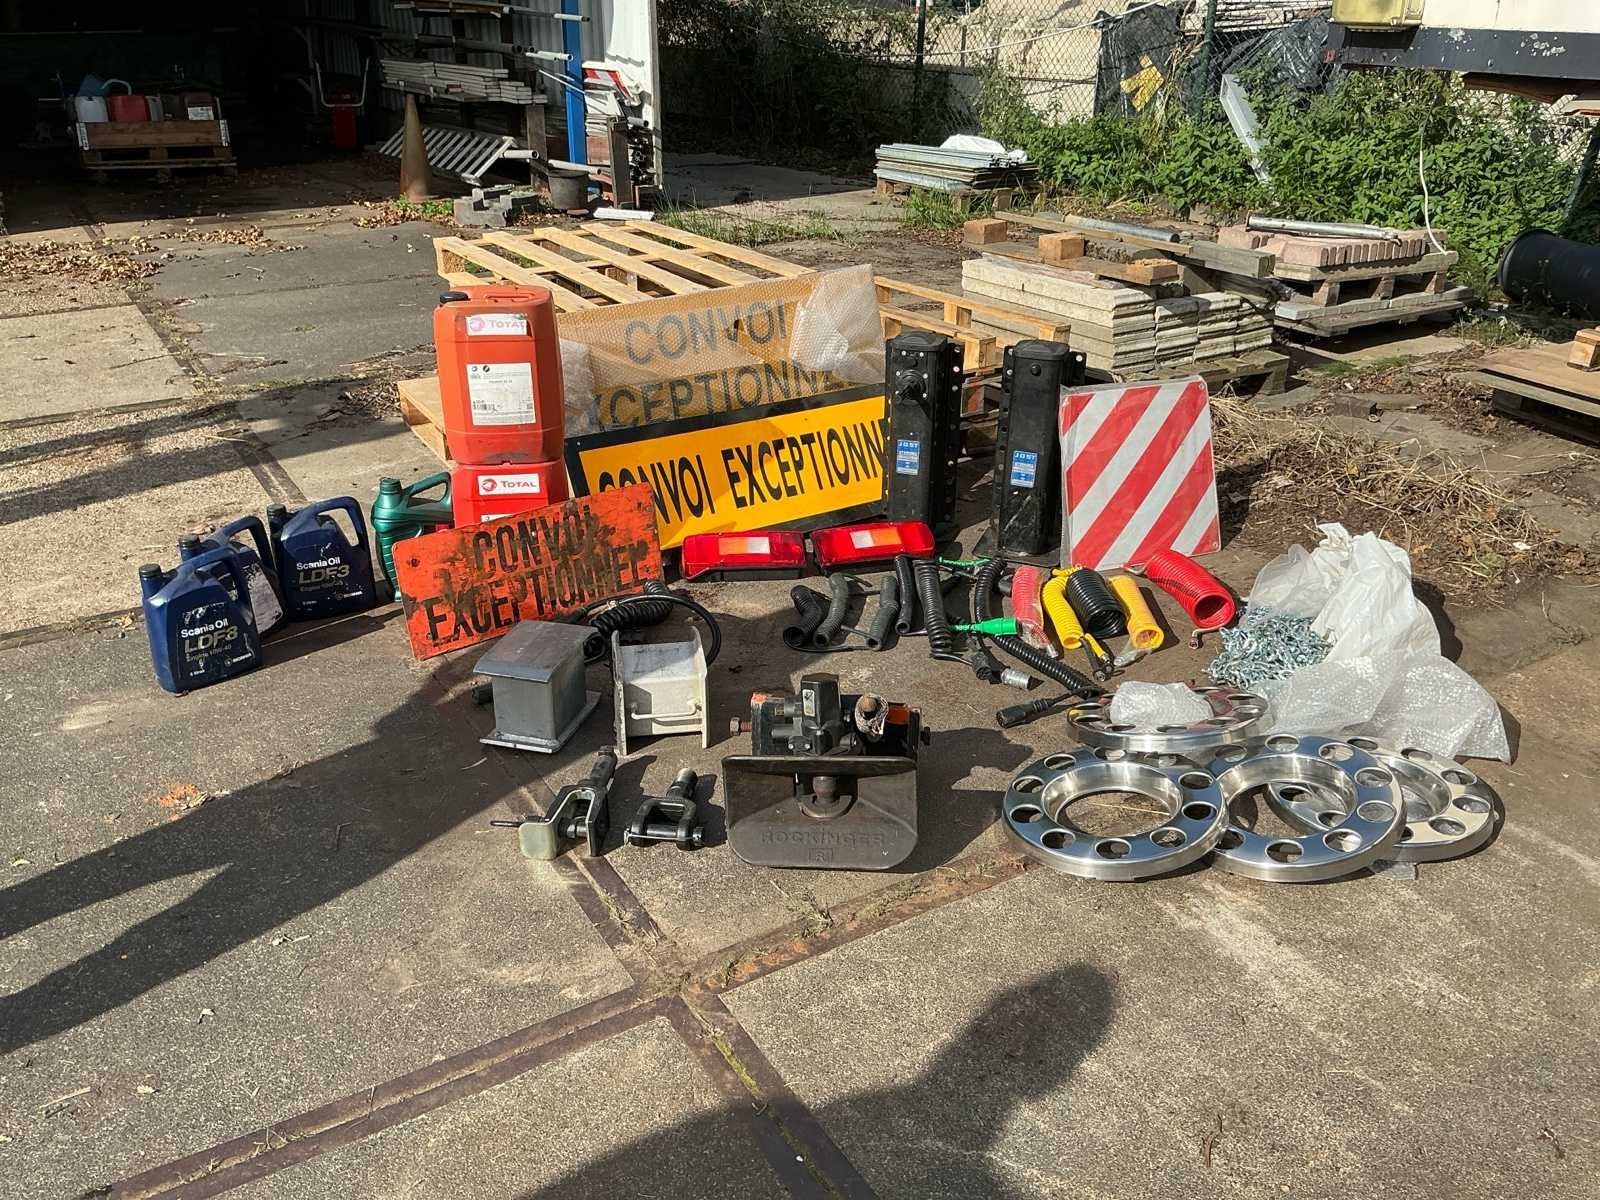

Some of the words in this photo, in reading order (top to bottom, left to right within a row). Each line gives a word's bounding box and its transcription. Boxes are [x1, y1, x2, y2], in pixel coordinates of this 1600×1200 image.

[623, 300, 788, 365] CONVOI
[720, 418, 884, 510] EXCEPTIONN
[500, 480, 537, 488] TOTAL
[296, 560, 327, 570] Scania
[328, 557, 341, 565] Oil
[299, 564, 350, 584] LDF3
[181, 623, 215, 638] Scania
[215, 617, 229, 629] Oil
[184, 625, 239, 654] LDF3
